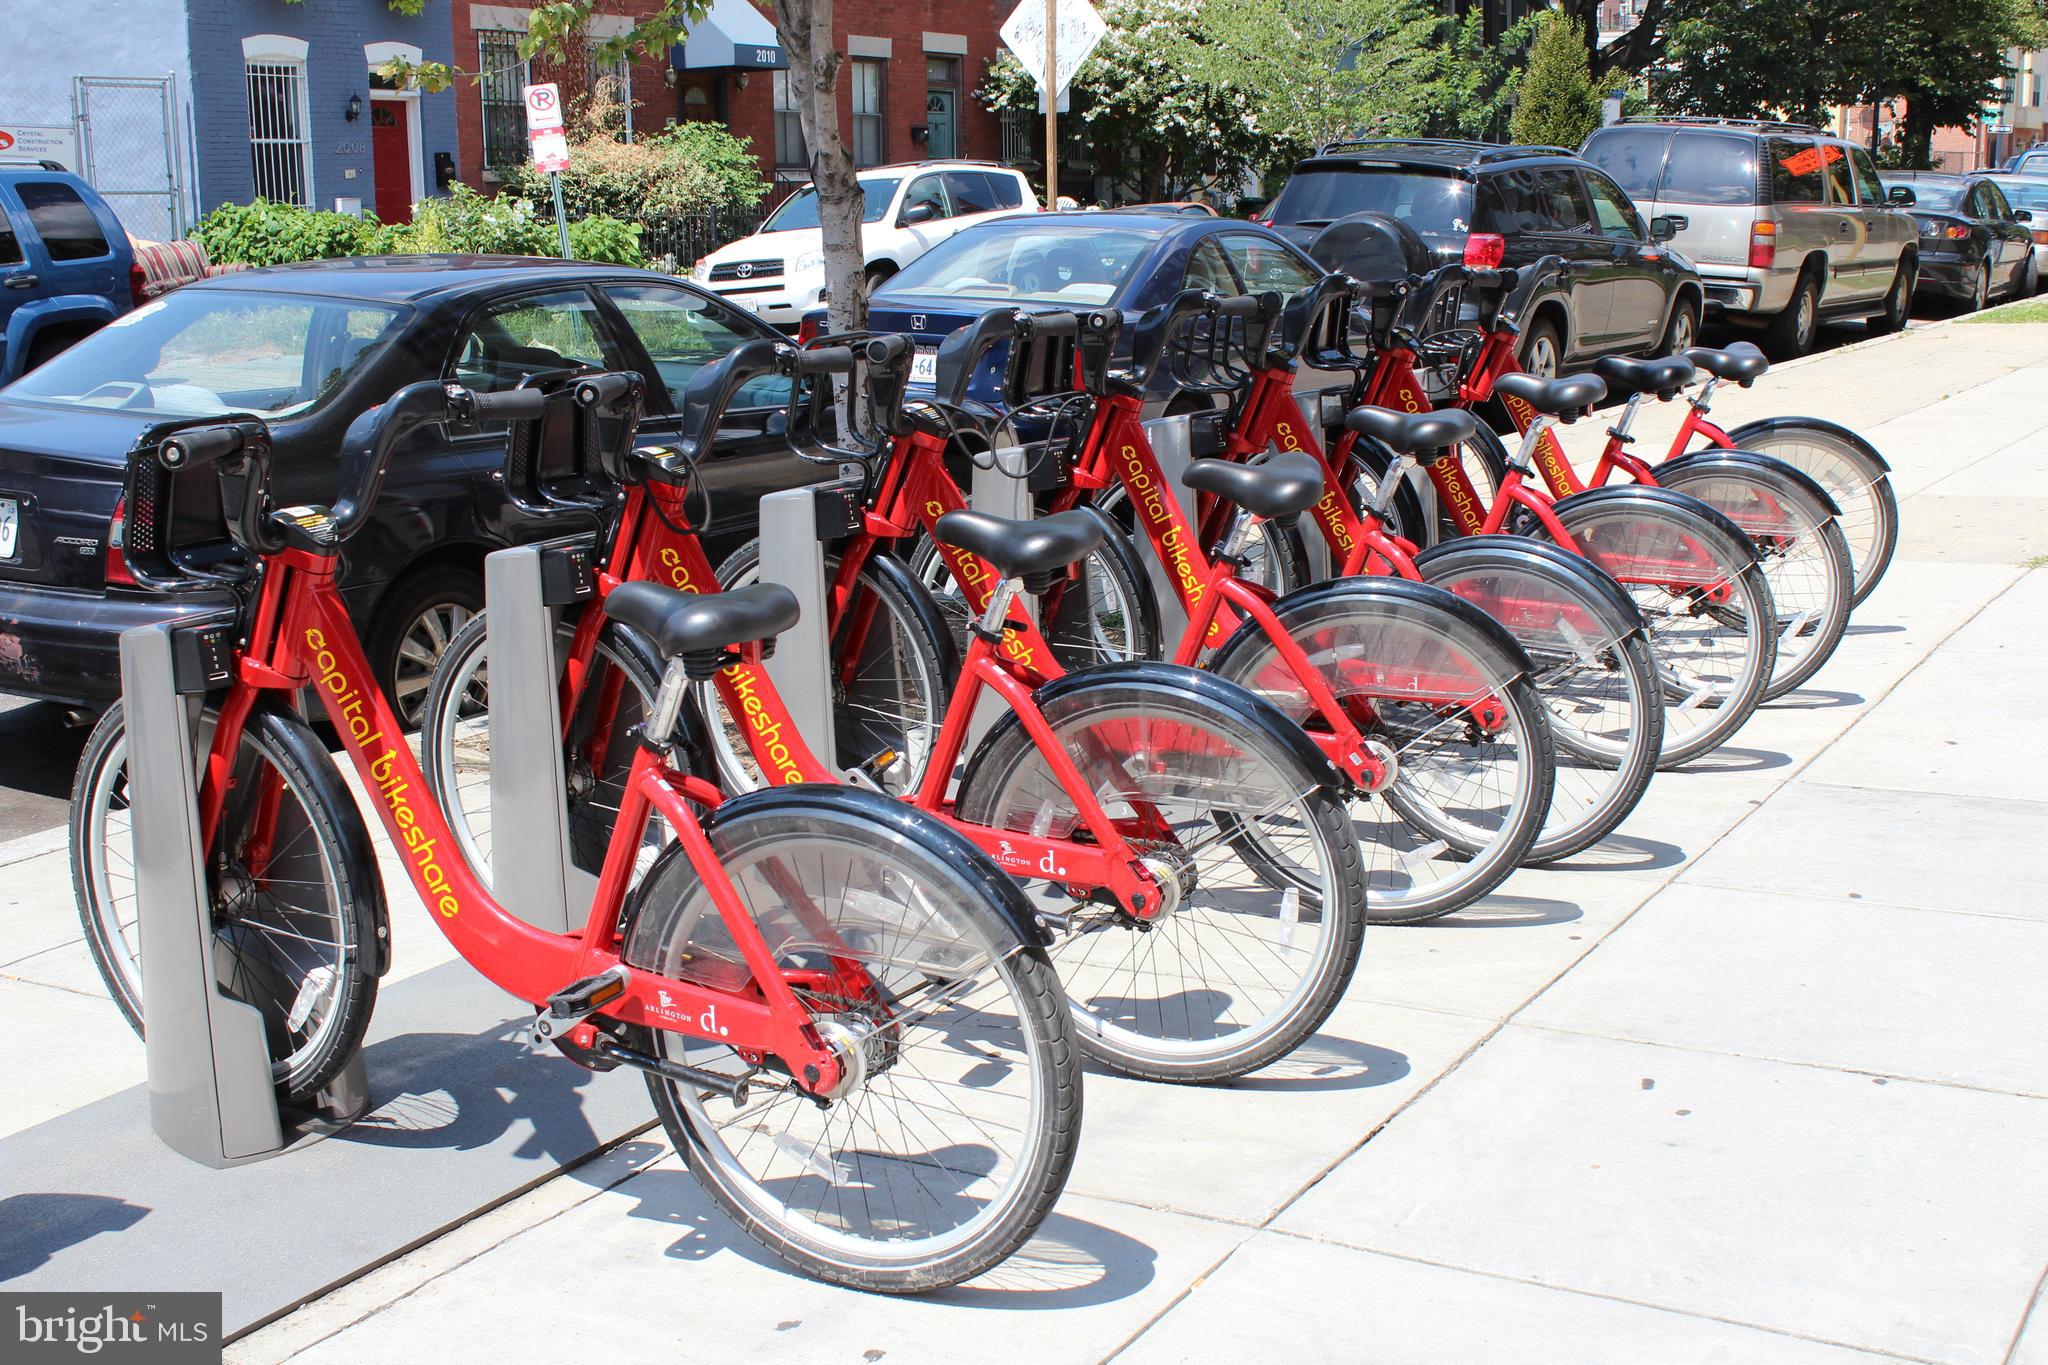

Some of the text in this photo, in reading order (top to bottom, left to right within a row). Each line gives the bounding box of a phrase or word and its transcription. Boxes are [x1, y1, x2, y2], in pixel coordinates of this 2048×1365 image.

[756, 49, 776, 64] 2010
[335, 141, 366, 154] 2008
[1121, 445, 1173, 525] capital
[54, 536, 99, 547] ACCORD
[305, 628, 383, 748] capital
[370, 748, 459, 918] bikeshare
[990, 853, 1032, 867] RLINGTON
[644, 1004, 693, 1023] ARLINGTON
